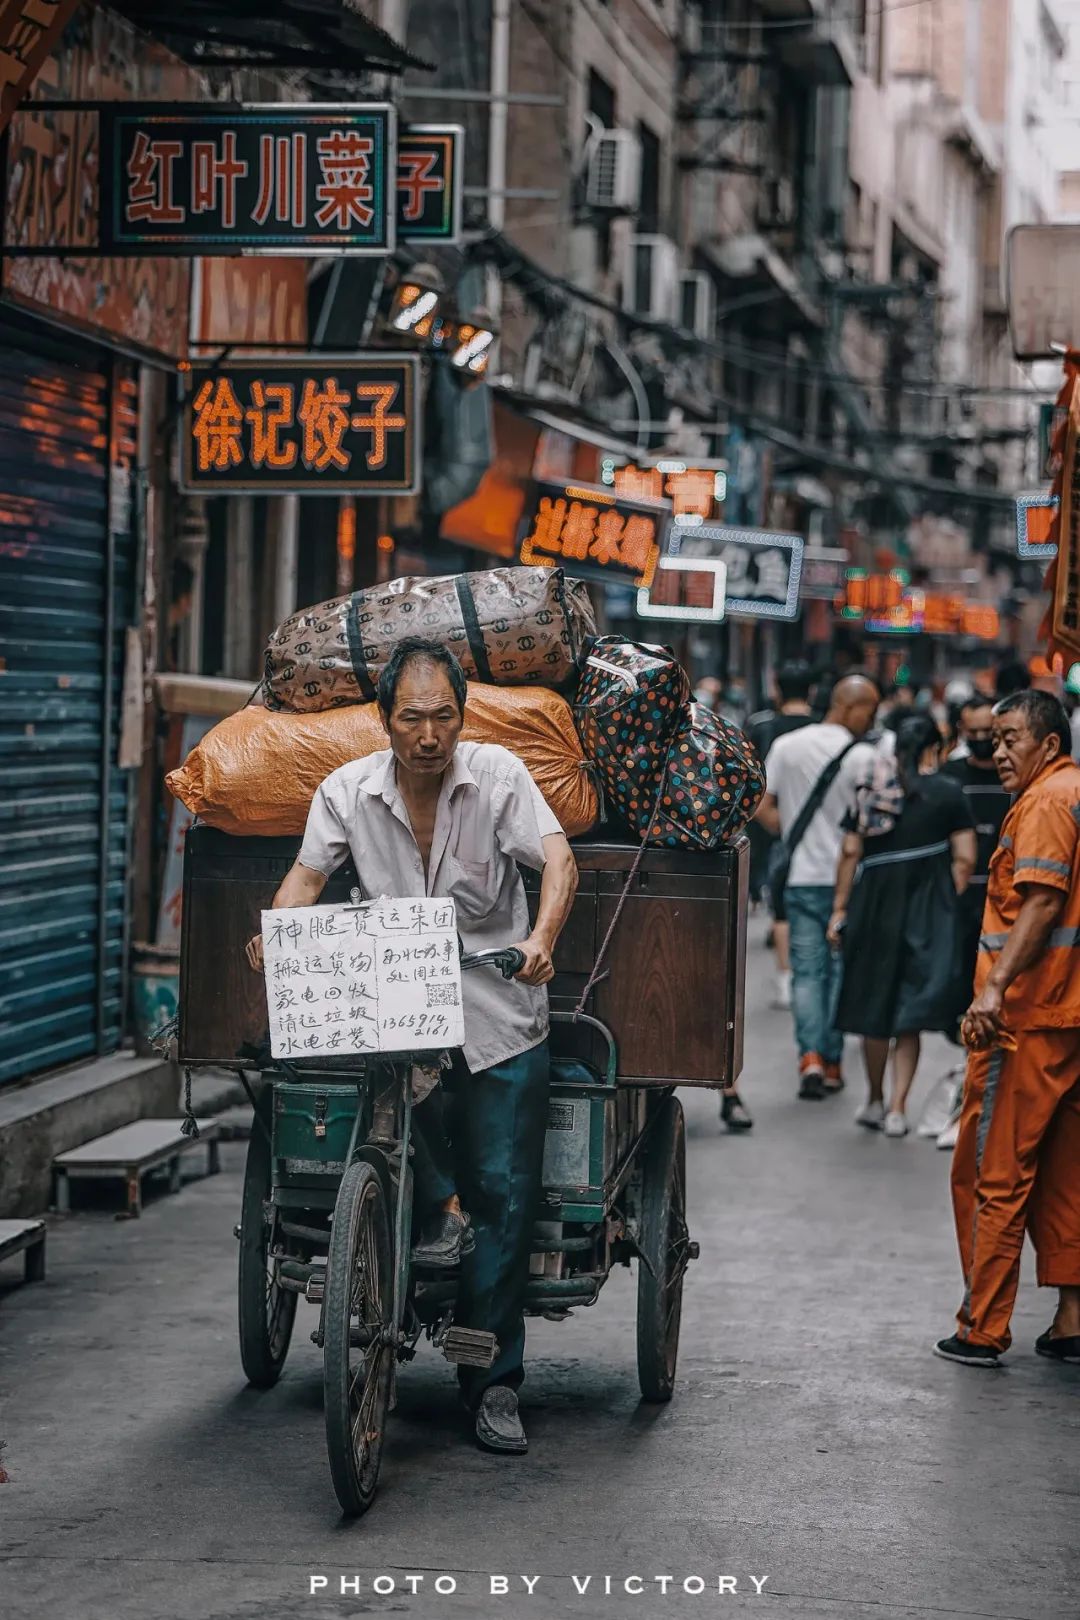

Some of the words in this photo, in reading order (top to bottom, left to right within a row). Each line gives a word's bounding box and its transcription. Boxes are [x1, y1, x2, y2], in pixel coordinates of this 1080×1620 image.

[126, 131, 375, 229] 红叶川菜
[192, 377, 406, 471] 徐记饺子
[273, 951, 372, 979] 搬运货物
[275, 982, 379, 1010] 家电回收
[383, 1013, 447, 1029] 1365914
[415, 1024, 449, 1036] 2161
[280, 1026, 376, 1054] 水电安装
